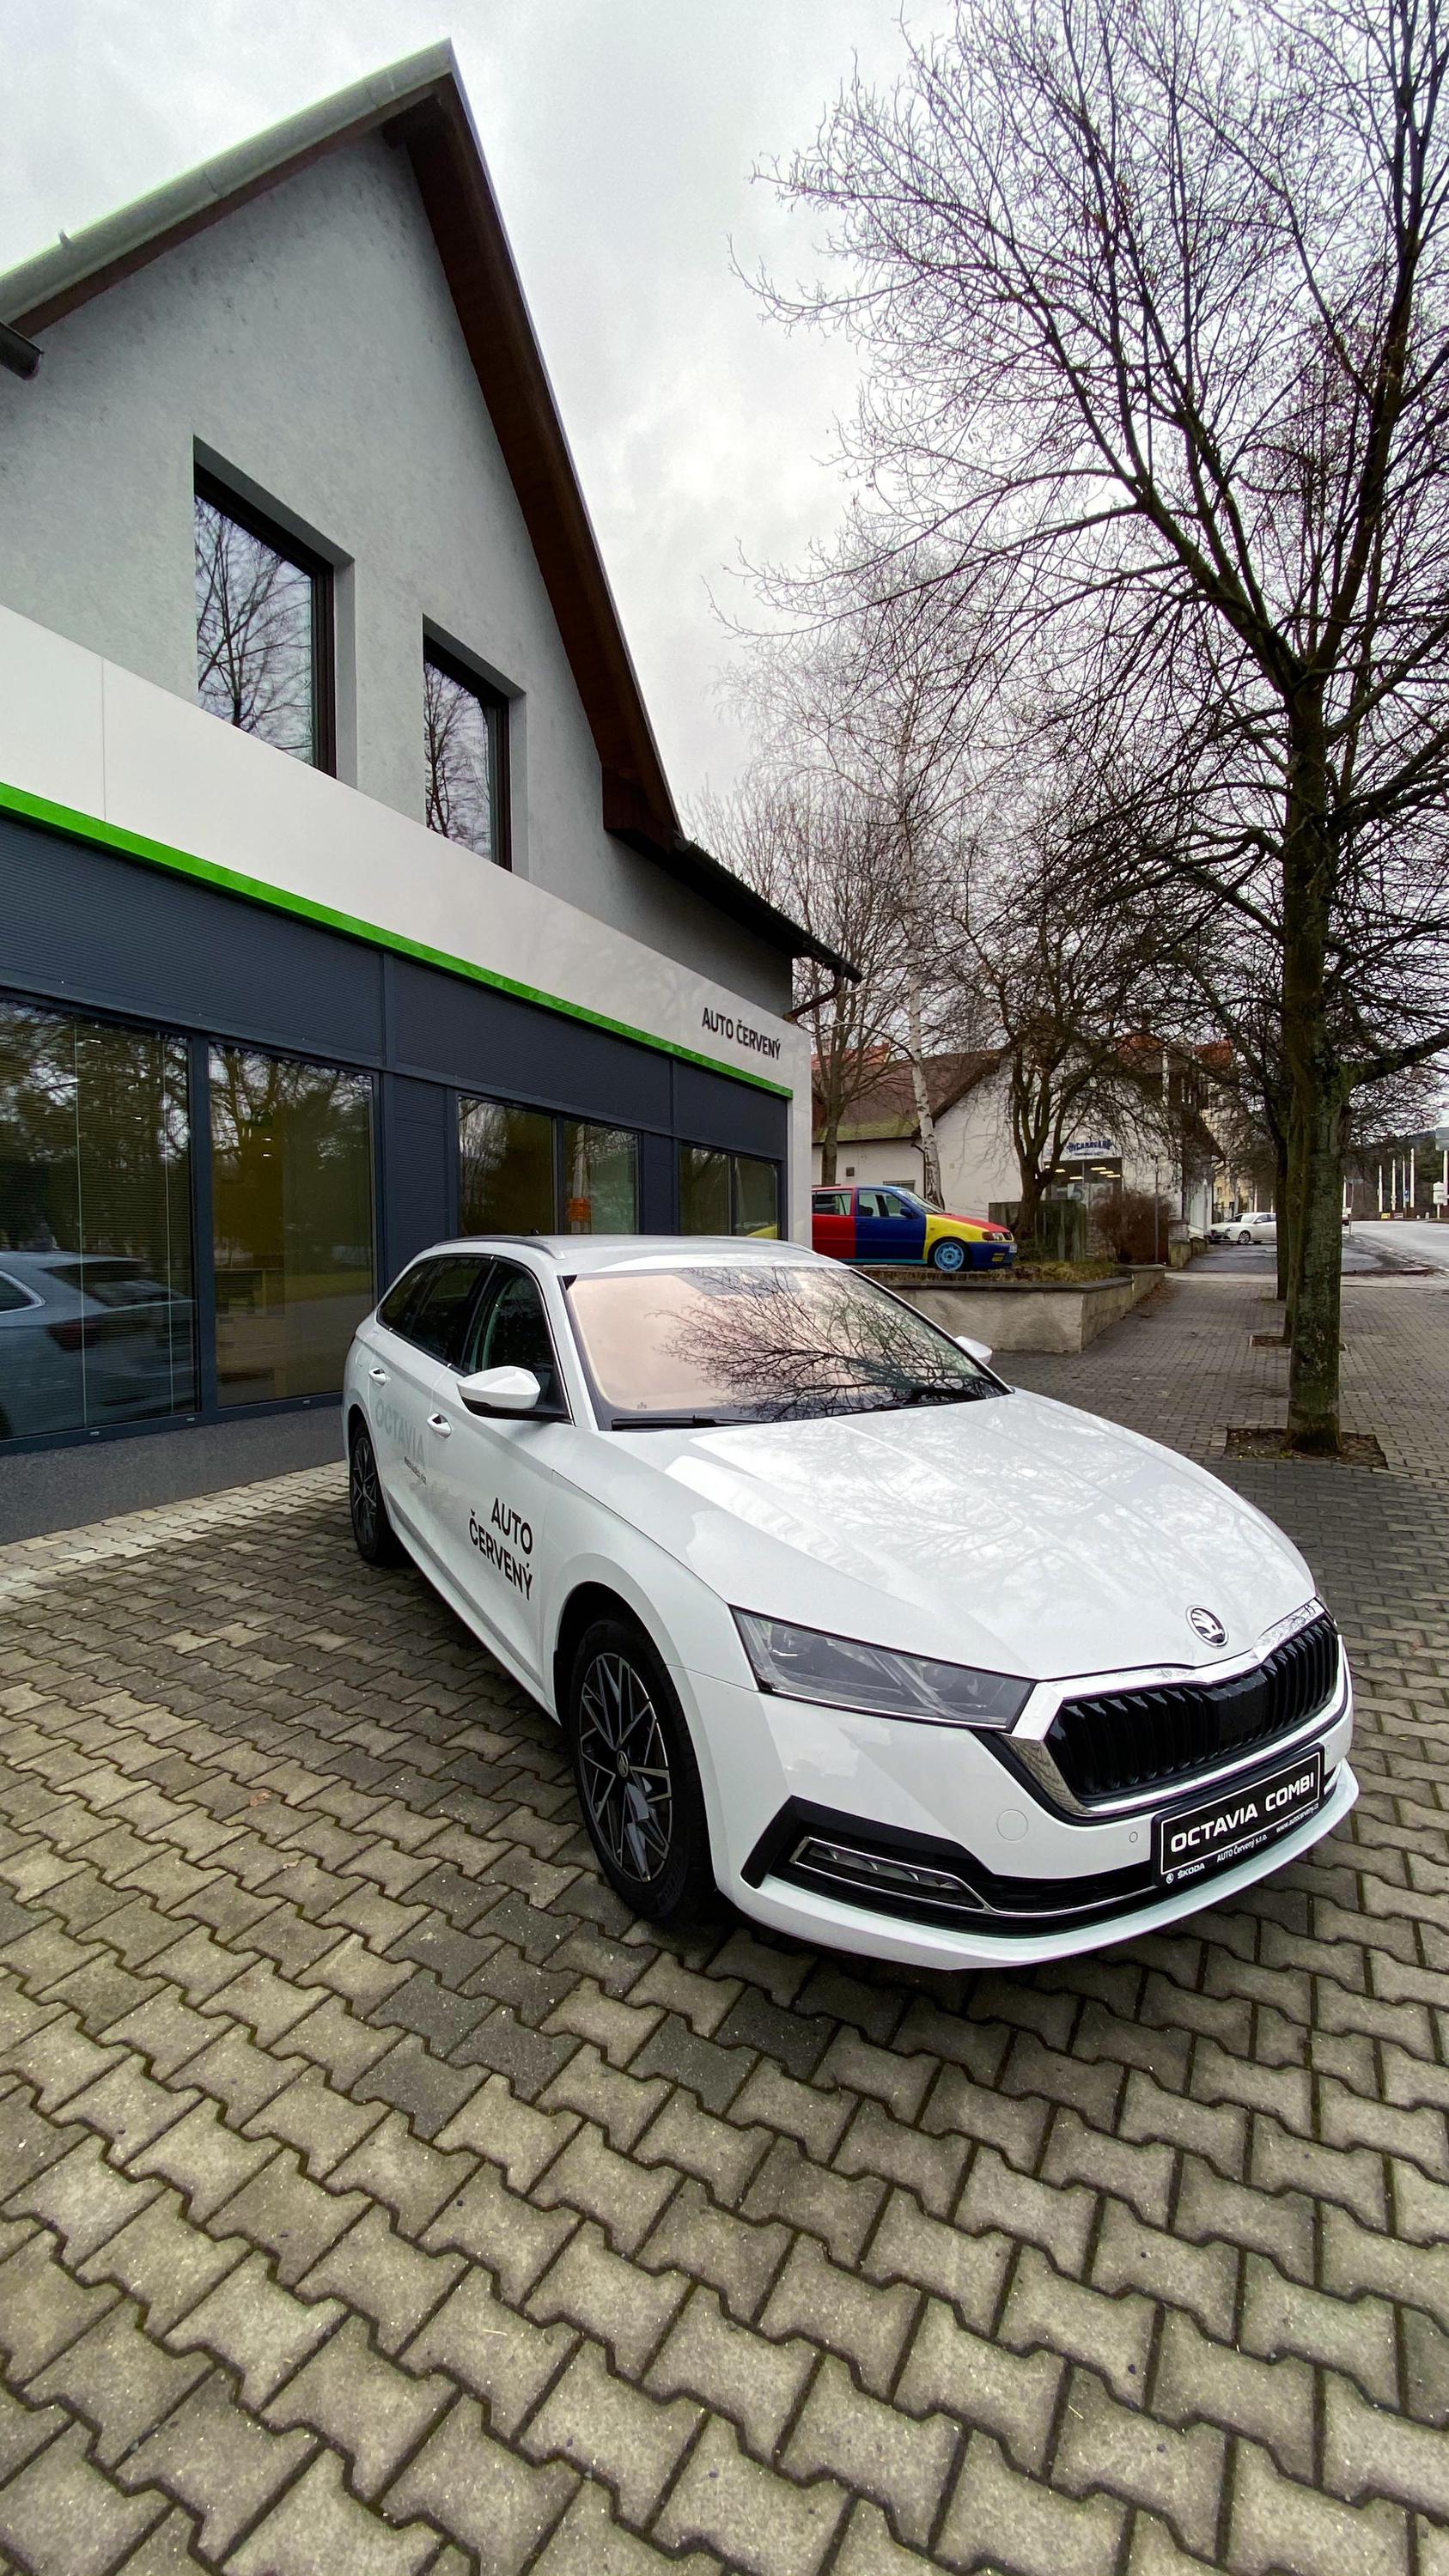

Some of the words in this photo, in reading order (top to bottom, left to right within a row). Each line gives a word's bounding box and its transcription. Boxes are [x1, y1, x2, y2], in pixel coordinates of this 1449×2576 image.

[701, 1007, 734, 1039] AUTO
[736, 1019, 781, 1060] ČERVENÝ
[375, 1398, 426, 1470] OCTAVIA
[469, 1509, 533, 1601] ČERVENÝ
[490, 1497, 533, 1555] AUTO
[1171, 1803, 1258, 1853] OCTAVIA
[1265, 1771, 1314, 1811] COMBI
[1177, 1862, 1205, 1880] ŠKODA
[1216, 1849, 1233, 1862] AUTO
[1233, 1838, 1255, 1855] Červený
[1255, 1834, 1268, 1845] s.r.o.
